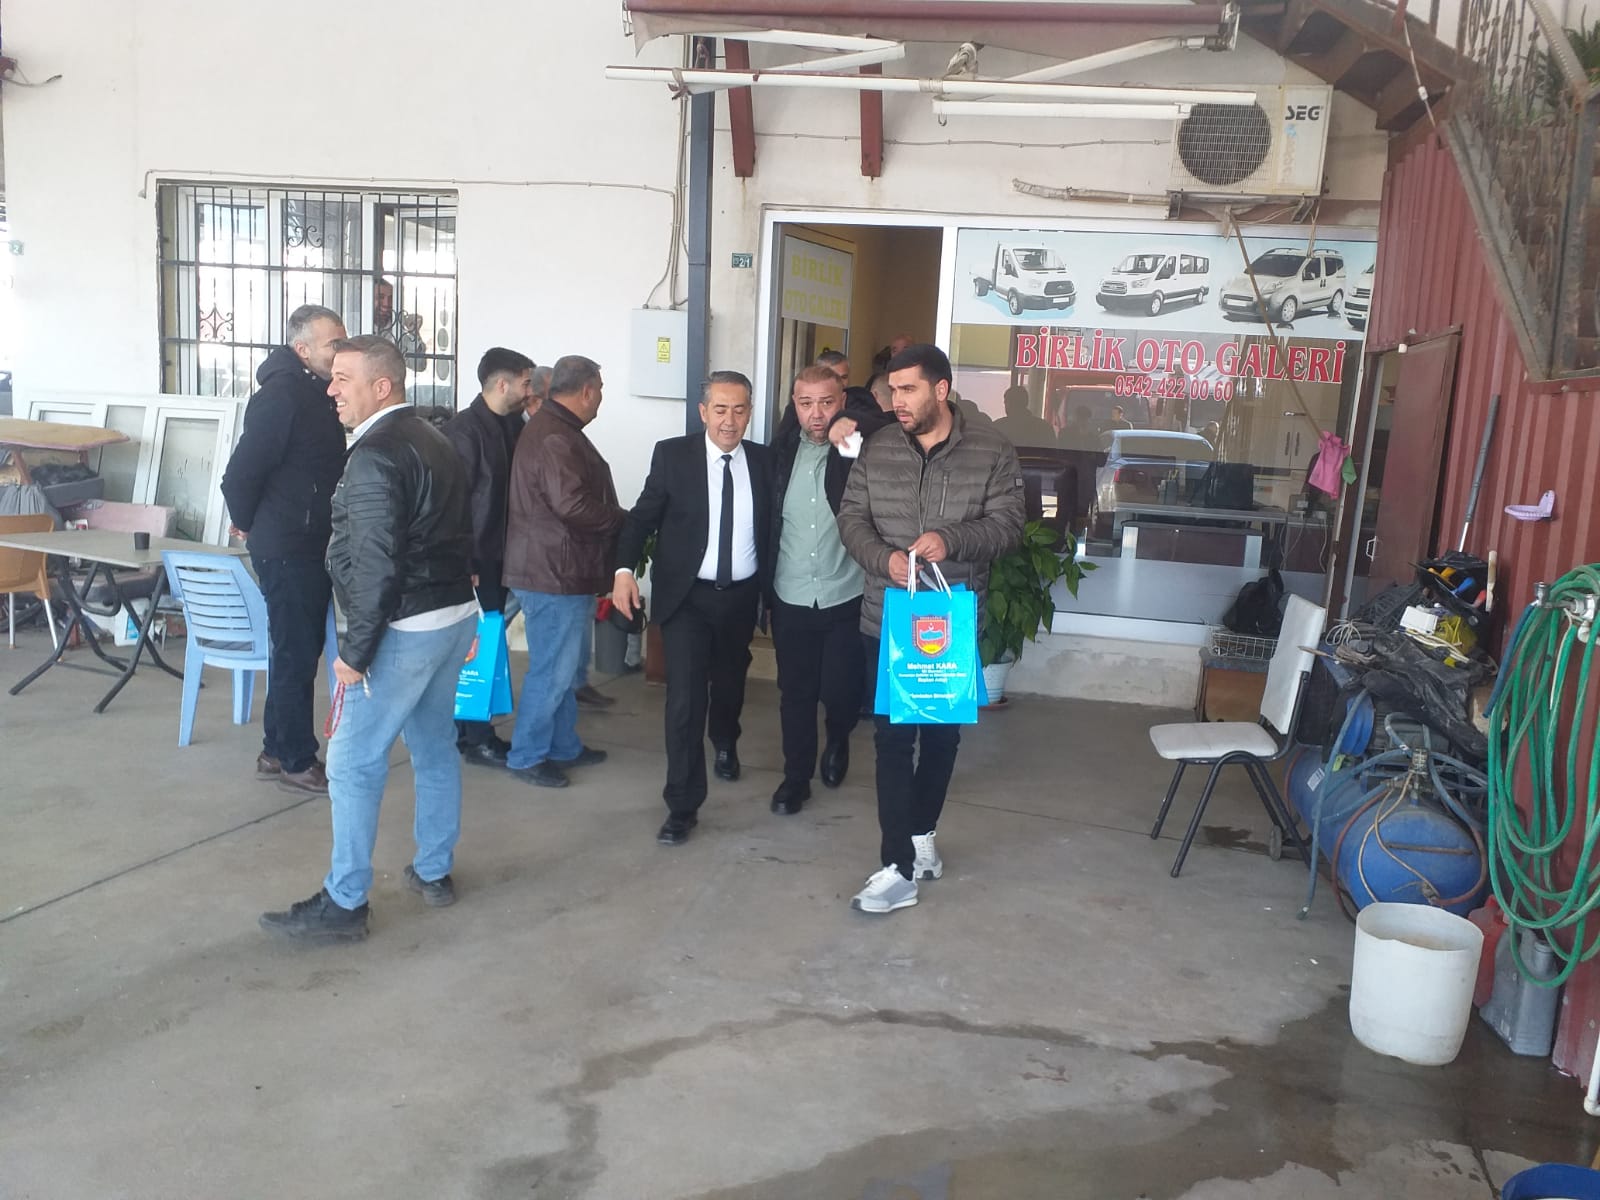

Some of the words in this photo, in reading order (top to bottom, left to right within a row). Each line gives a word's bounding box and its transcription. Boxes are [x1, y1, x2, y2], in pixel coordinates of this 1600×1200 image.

[1285, 105, 1321, 121] SEG
[792, 252, 844, 287] BİRLİK
[784, 288, 807, 313] OTO
[1015, 326, 1126, 371] BİRLİK
[1136, 338, 1206, 376] OTO
[1215, 340, 1346, 384] GALERİ
[1114, 375, 1153, 398] 0542
[1156, 377, 1187, 399] 422
[1190, 379, 1209, 401] 00
[1214, 380, 1234, 402] 60
[907, 662, 935, 670] Mehmet
[936, 662, 957, 670] KARA
